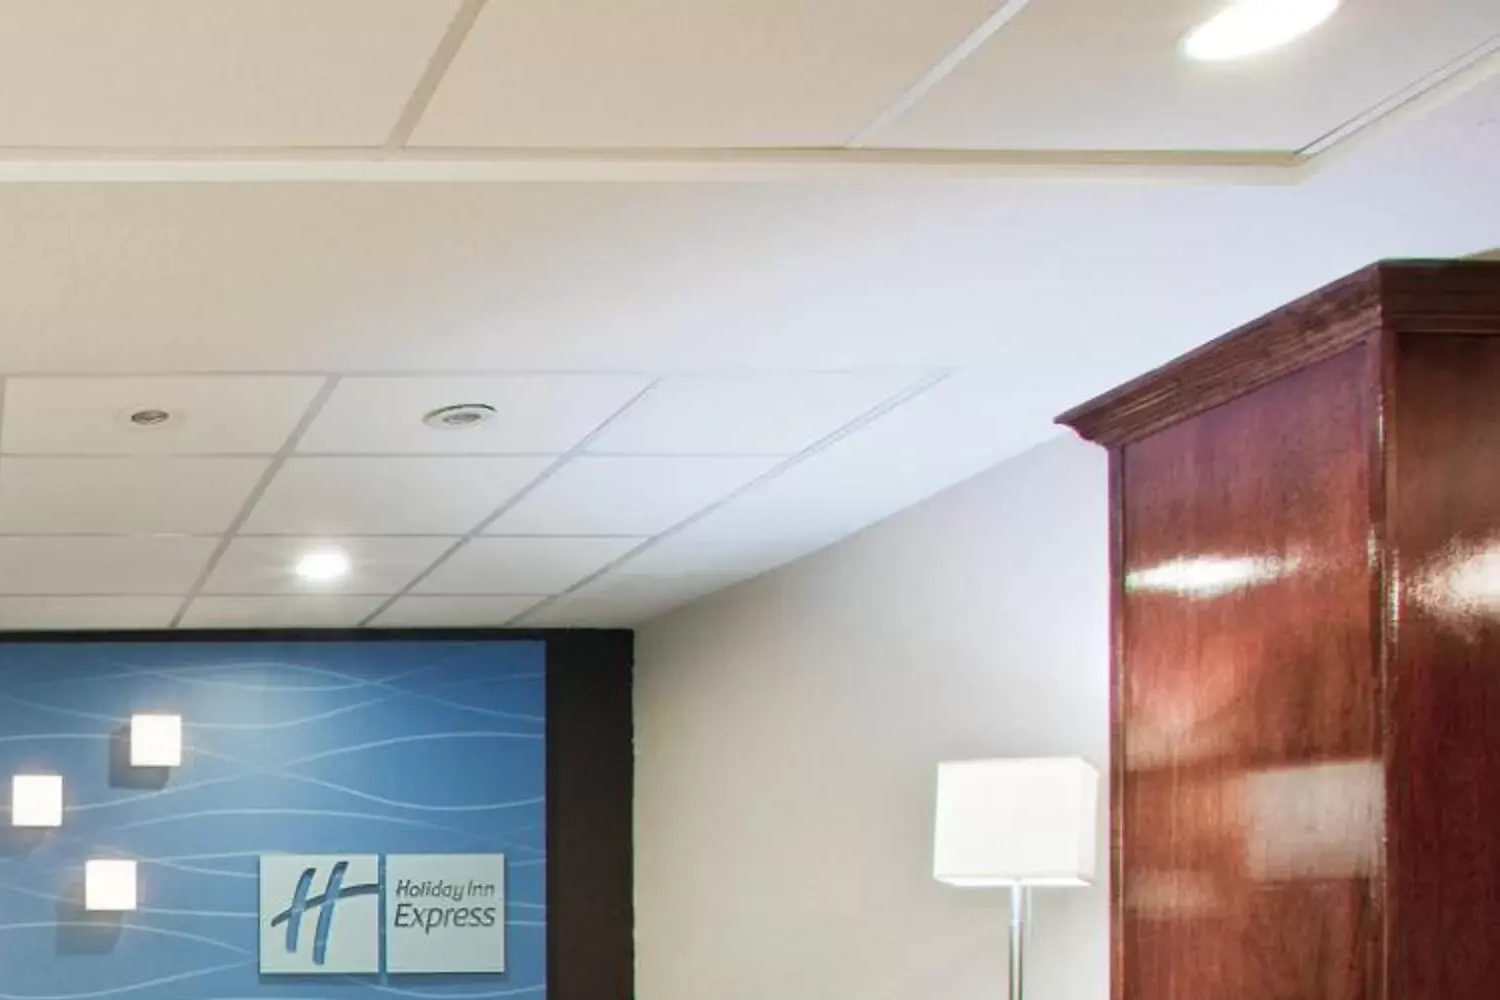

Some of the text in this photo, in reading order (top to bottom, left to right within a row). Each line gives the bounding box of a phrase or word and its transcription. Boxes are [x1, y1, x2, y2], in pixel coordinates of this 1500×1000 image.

[395, 879, 496, 901] Holiday Inn
[394, 903, 497, 935] Express
